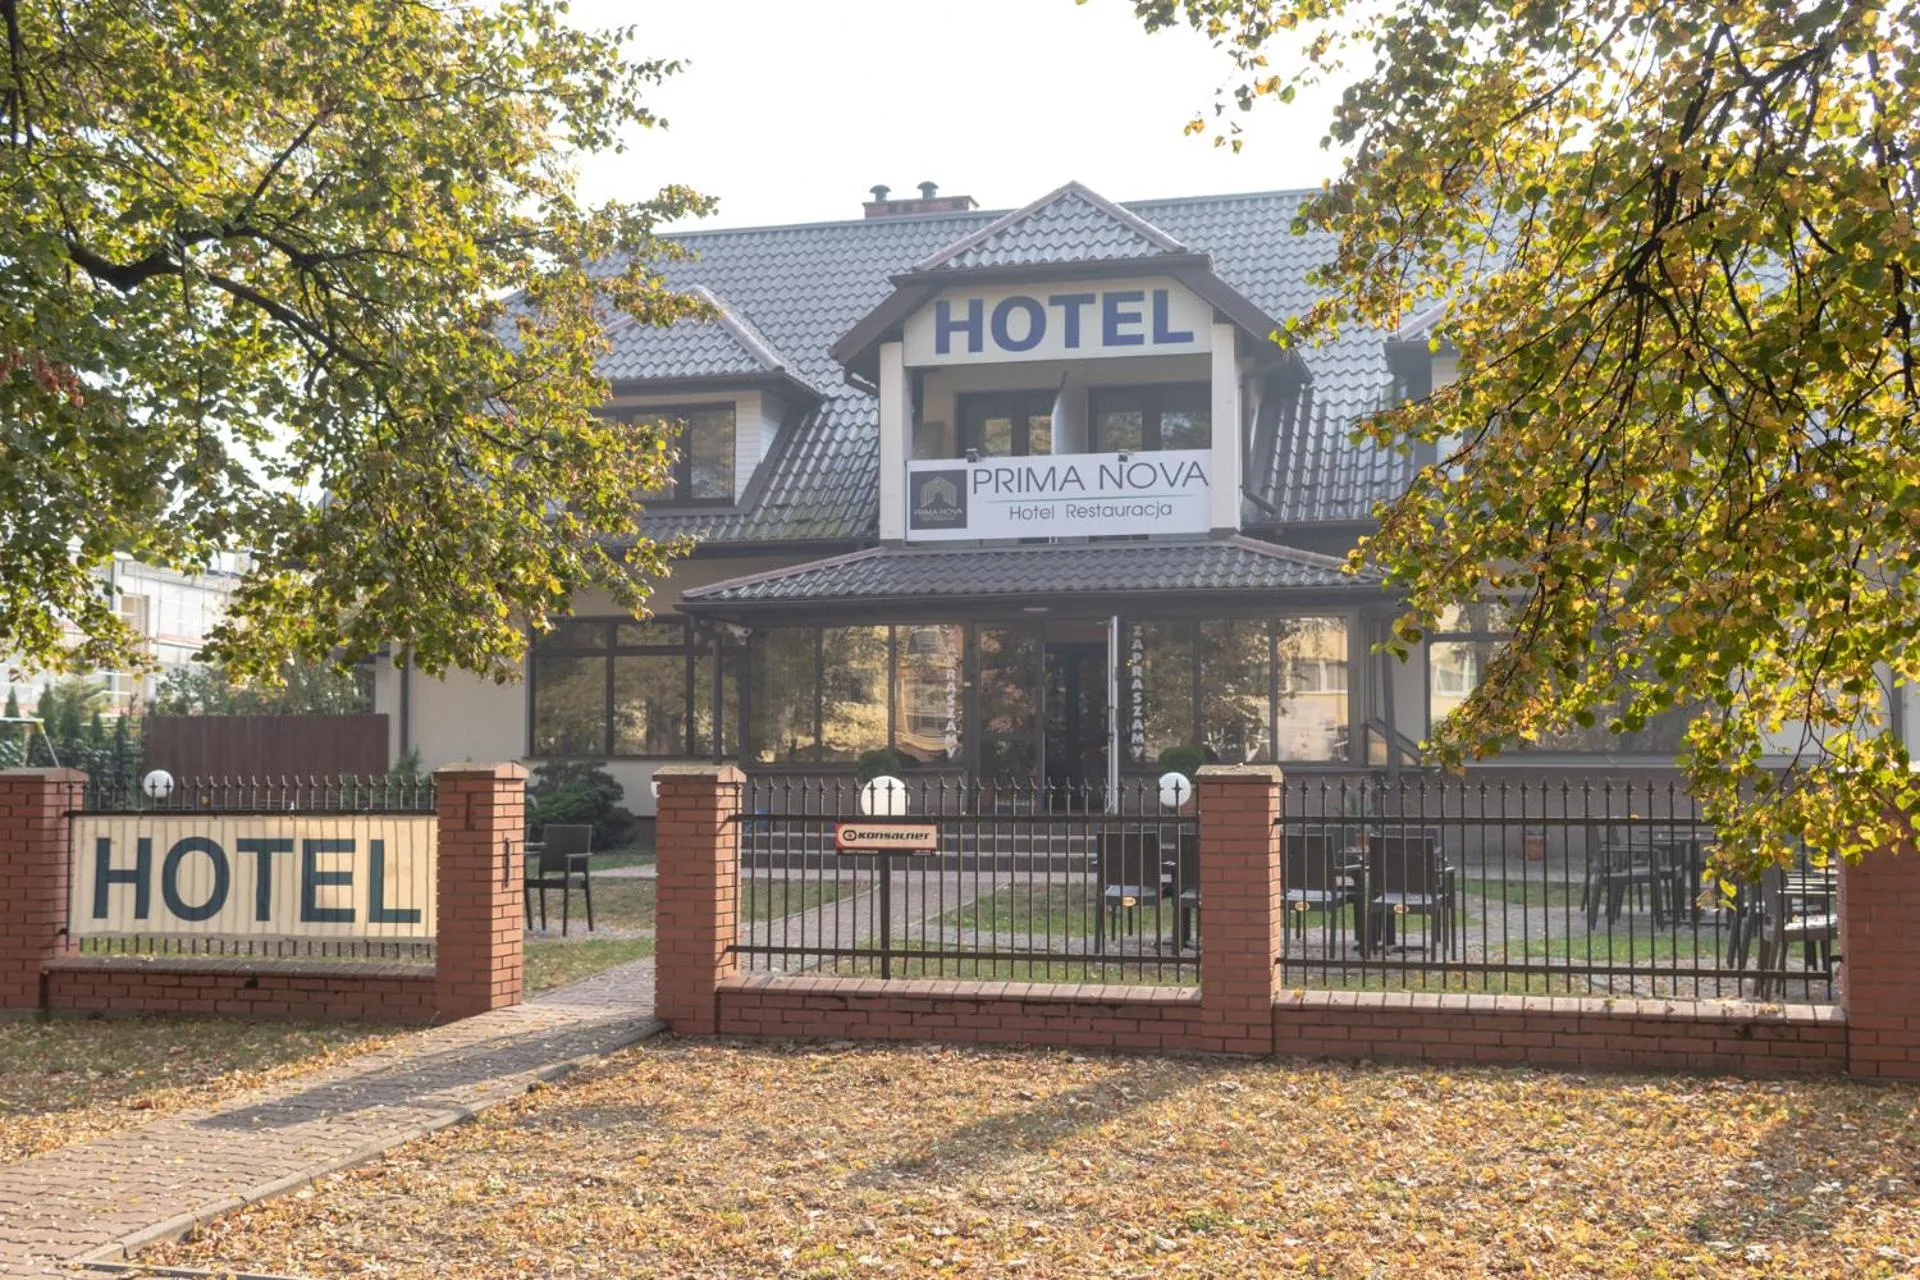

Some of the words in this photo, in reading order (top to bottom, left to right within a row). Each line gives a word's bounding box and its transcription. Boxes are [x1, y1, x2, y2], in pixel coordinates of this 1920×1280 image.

[935, 289, 1194, 355] HOTEL
[972, 465, 1086, 495] PRIMA
[1099, 460, 1209, 491] NOVA
[1009, 504, 1055, 521] Hotel
[1065, 501, 1173, 521] Restauracja
[945, 629, 958, 758] APRASZAMY
[1131, 625, 1144, 757] ZAPRASZAMY
[92, 836, 421, 923] HOTEL
